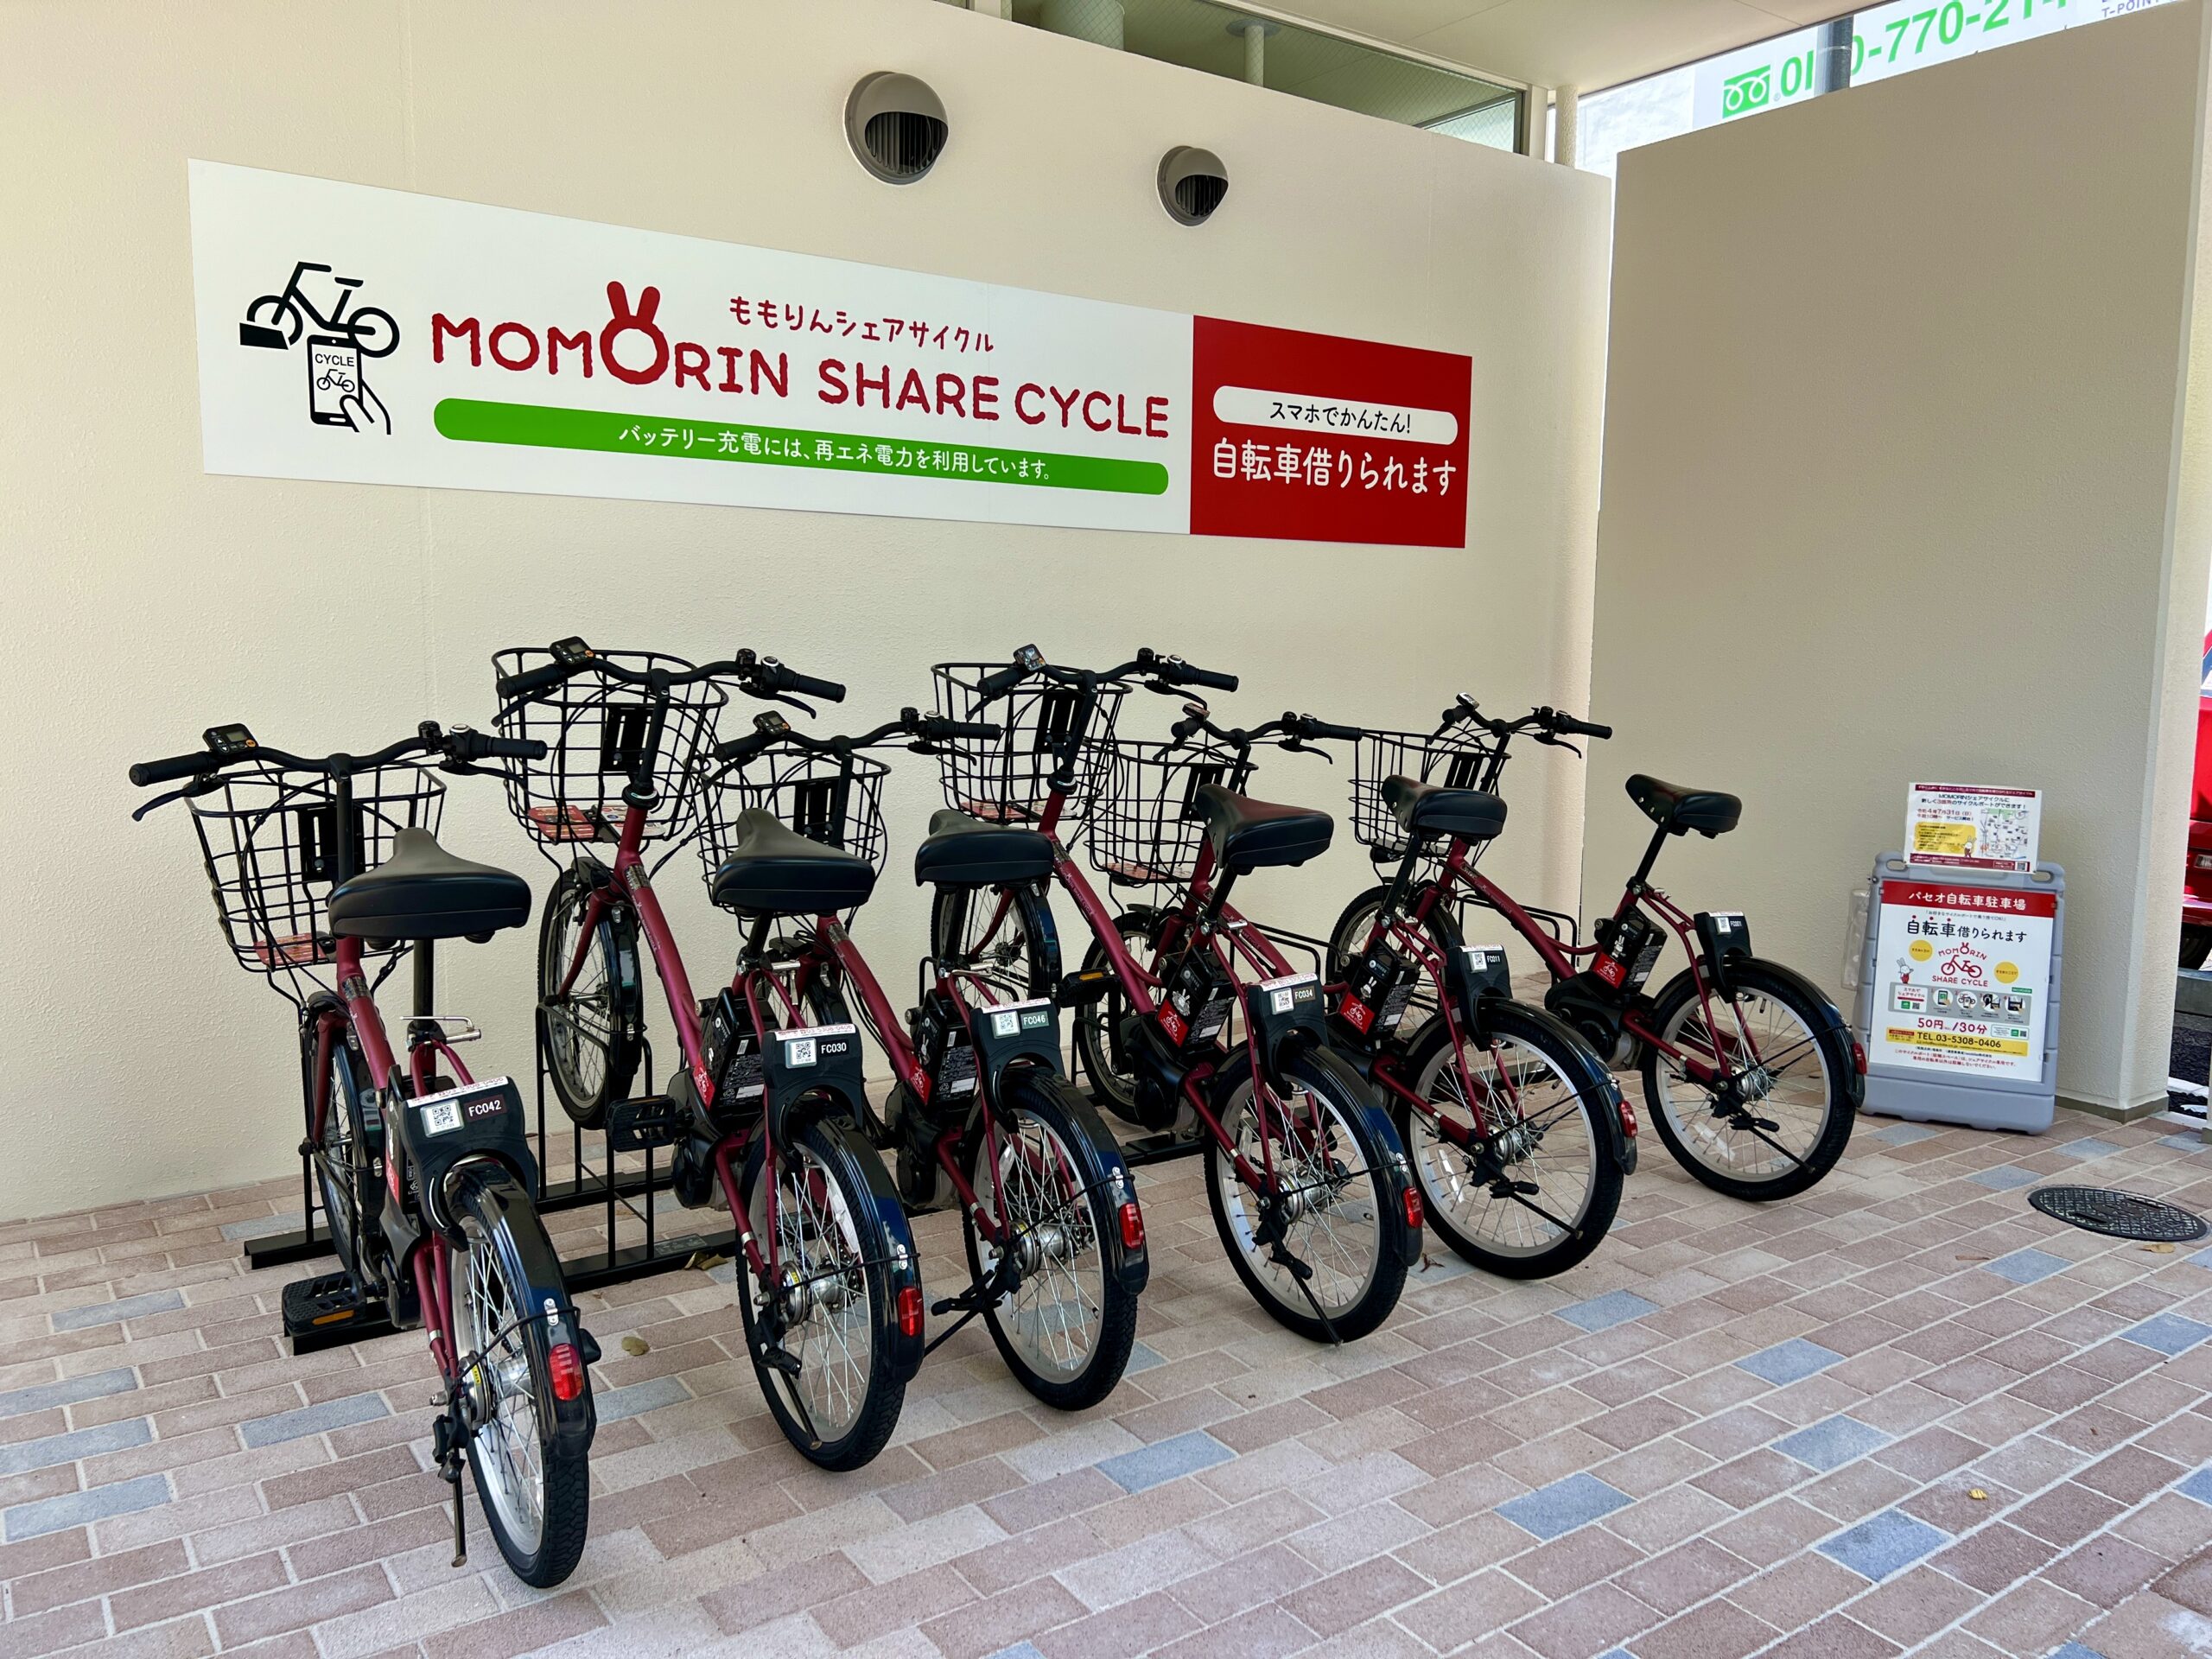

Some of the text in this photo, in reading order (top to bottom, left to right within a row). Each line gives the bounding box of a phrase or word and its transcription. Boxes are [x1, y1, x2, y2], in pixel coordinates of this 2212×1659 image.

[729, 296, 995, 354] ももりんシェアサイクル
[315, 353, 355, 368] CYCLE
[432, 282, 1170, 438] MOMORIN SHARE CYCLE
[619, 424, 1051, 482] バッテリー充電には、再エネ電力を利用しています。
[1212, 436, 1459, 497] 自転車借りられます
[1908, 891, 2027, 911] パセオ自転車駐車場
[1907, 919, 2027, 943] 自転車借りられます
[1938, 942, 1987, 961] MOMORIN
[1932, 975, 1988, 988] SHARE CYCLE
[1294, 988, 1313, 1000] FC034
[1023, 1014, 1046, 1027] FC046
[1917, 1017, 1943, 1030] 50円
[820, 1042, 848, 1054] FC030
[468, 1099, 502, 1117] FC042
